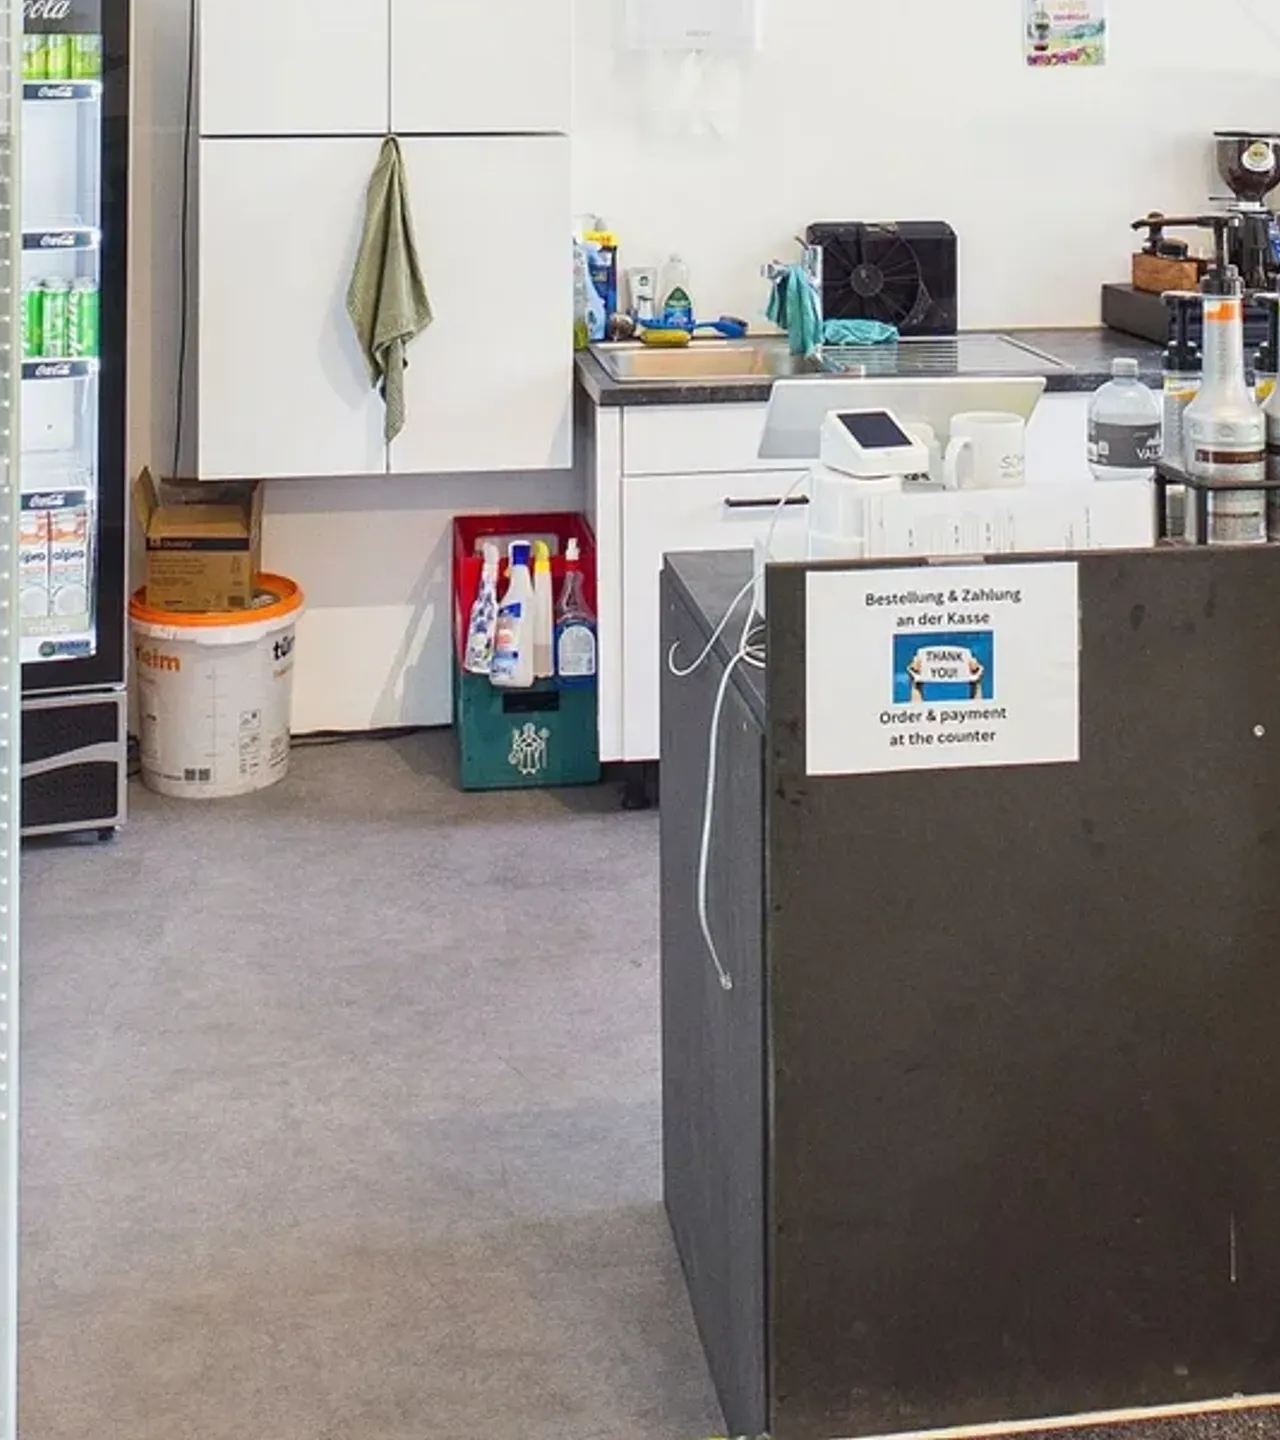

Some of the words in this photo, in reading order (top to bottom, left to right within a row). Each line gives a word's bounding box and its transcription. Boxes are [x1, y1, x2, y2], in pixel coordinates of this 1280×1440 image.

[865, 590, 944, 606] Bestellung
[947, 589, 958, 602] &
[961, 588, 1022, 603] Zahlung
[896, 615, 915, 627] an
[918, 612, 942, 626] der
[947, 611, 990, 625] Kasse
[926, 650, 964, 662] THANK
[880, 710, 923, 725] Order
[926, 708, 937, 722] &
[940, 707, 1007, 724] payment
[889, 734, 905, 747] at
[909, 731, 934, 746] the
[937, 730, 996, 744] counter
